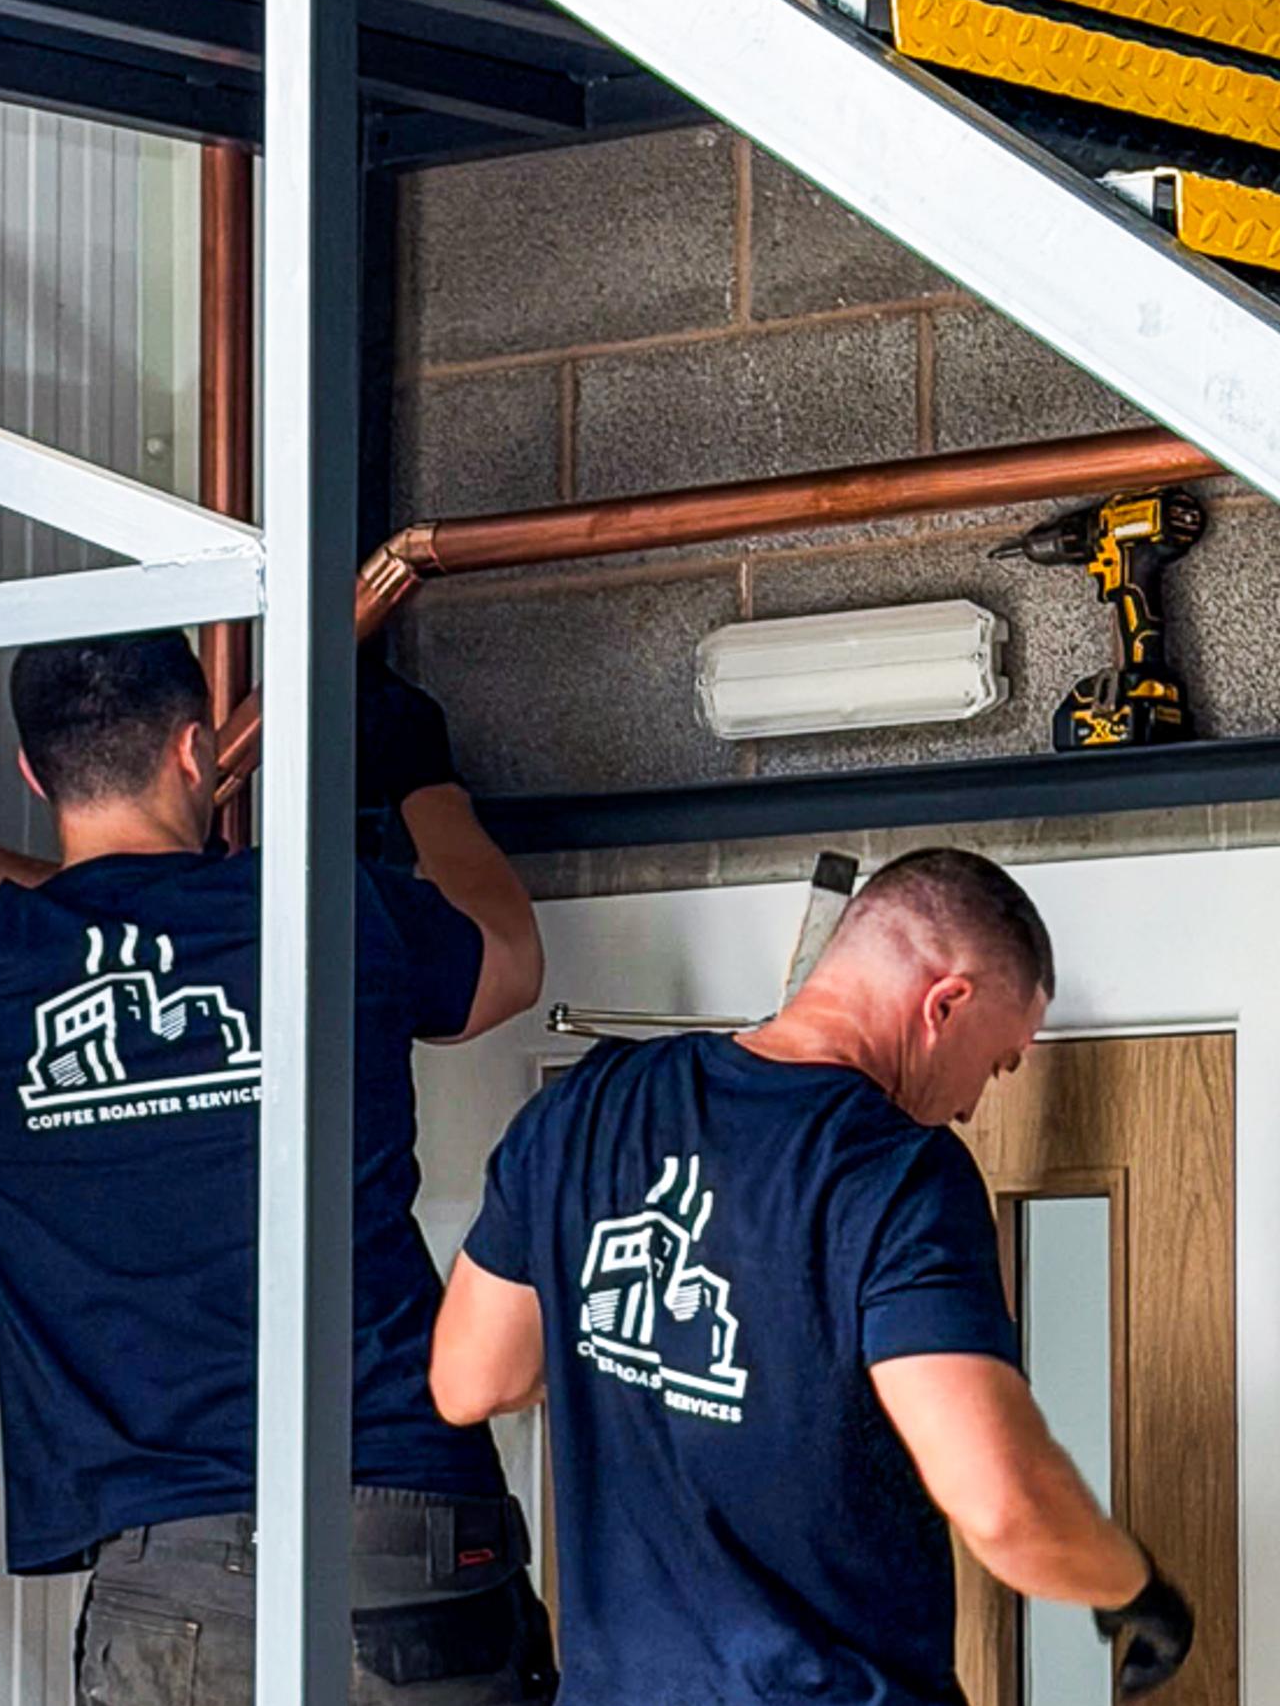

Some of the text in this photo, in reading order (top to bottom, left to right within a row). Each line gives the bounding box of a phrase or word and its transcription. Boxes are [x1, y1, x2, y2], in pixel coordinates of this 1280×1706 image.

[27, 1085, 262, 1131] COFFEE ROASTER SERVICE
[664, 1389, 742, 1423] SERVICES
